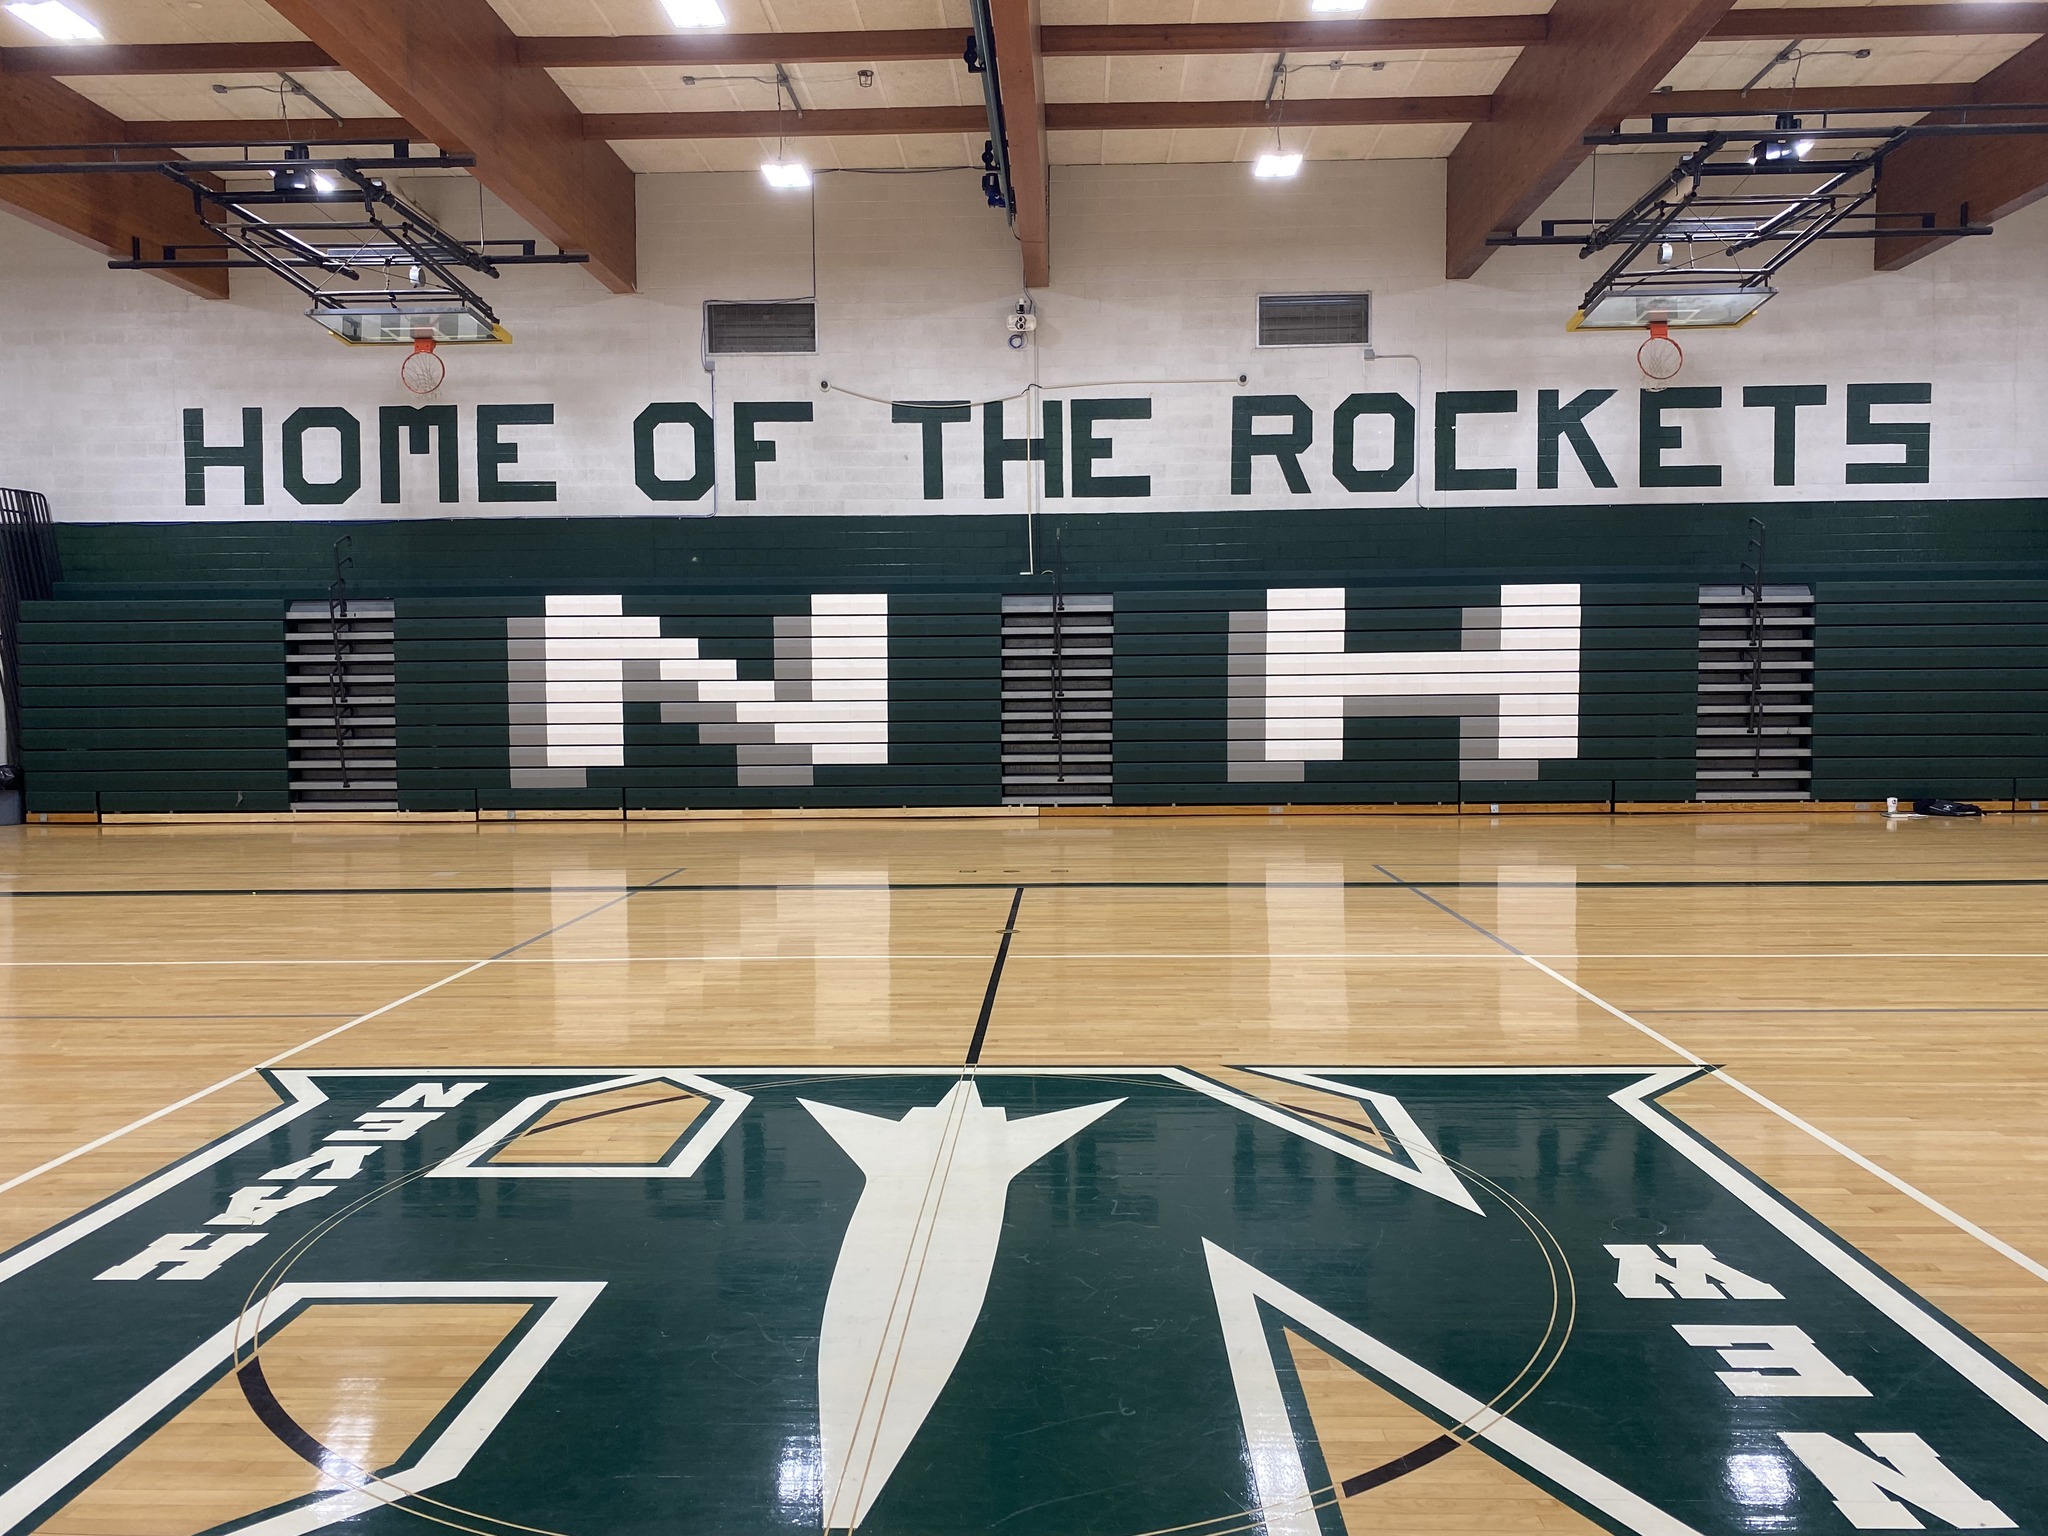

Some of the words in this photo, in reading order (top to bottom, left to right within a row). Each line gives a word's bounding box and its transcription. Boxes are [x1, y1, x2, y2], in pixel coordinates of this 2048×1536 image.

[183, 404, 556, 505] HOME
[633, 401, 813, 502] OF
[892, 399, 1151, 500] THE
[1231, 382, 1932, 495] ROCKETS
[92, 1082, 488, 1281] HAVEN
